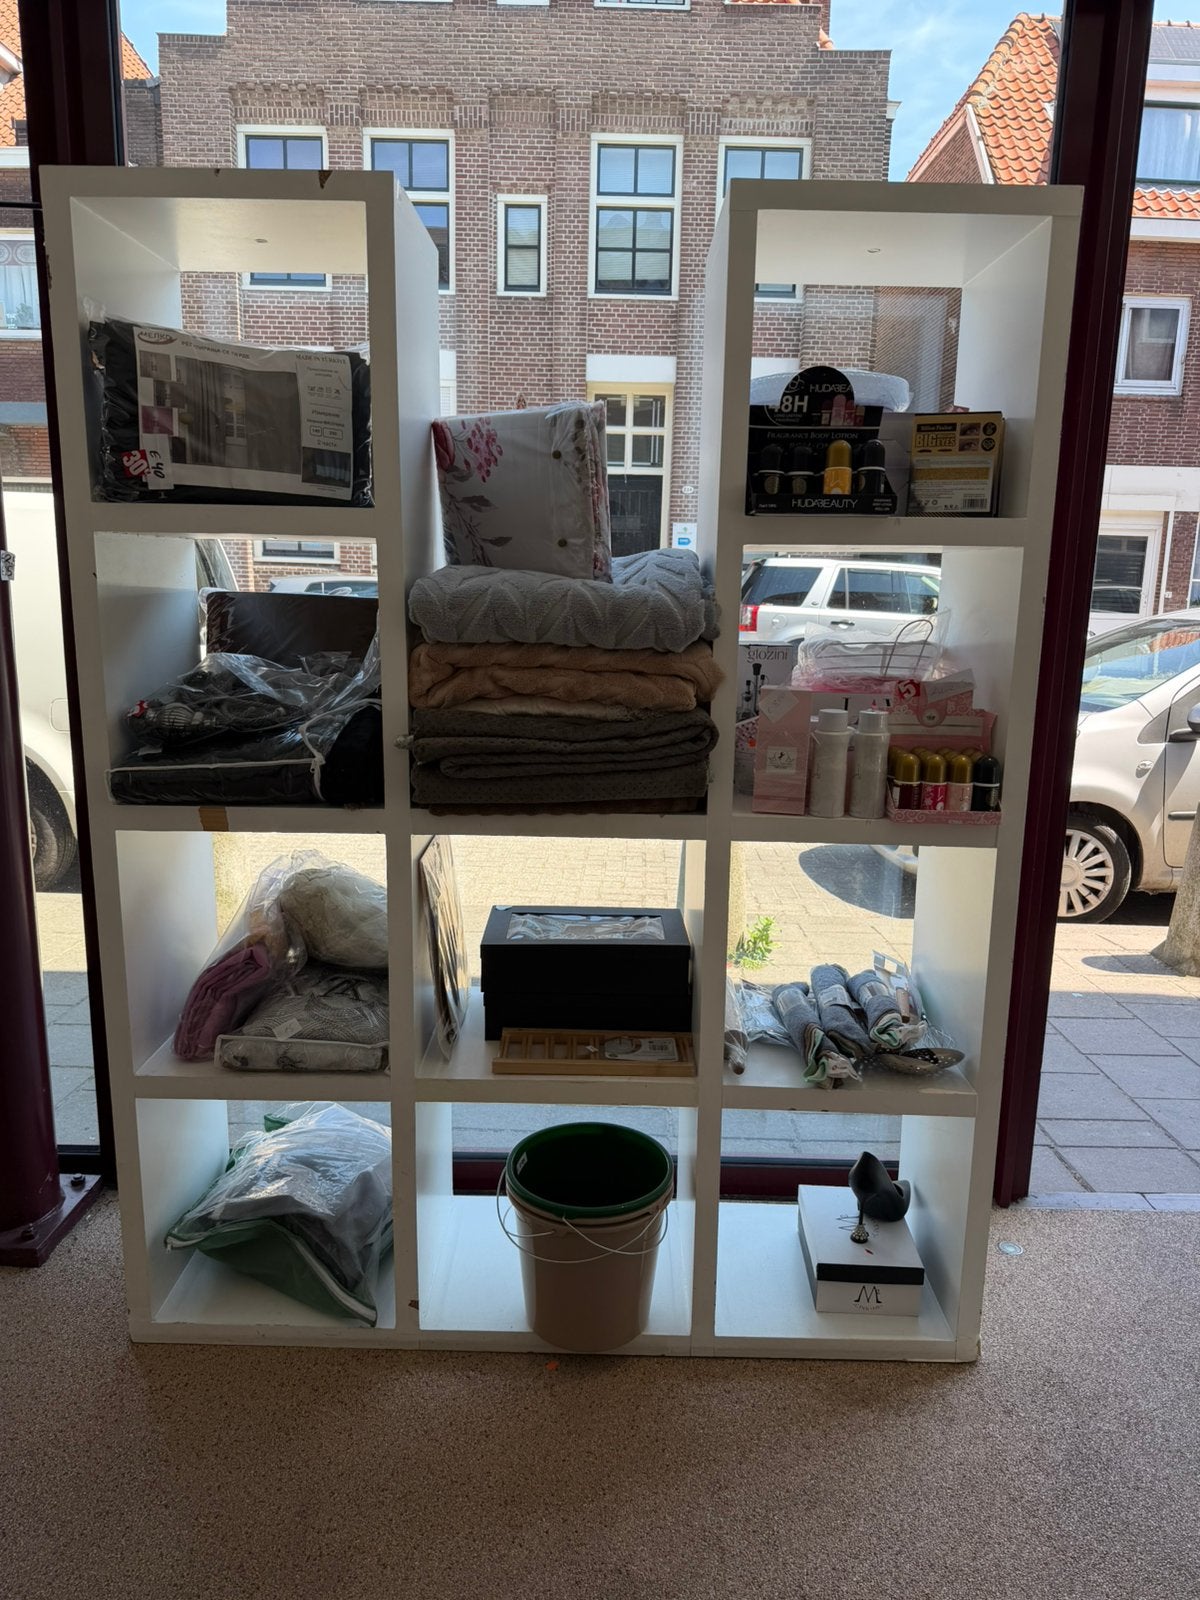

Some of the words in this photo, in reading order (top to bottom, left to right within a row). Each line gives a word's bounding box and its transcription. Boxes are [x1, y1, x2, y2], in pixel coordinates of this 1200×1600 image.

[915, 433, 937, 449] BIG
[791, 498, 859, 509] HUDABEAUTY
[747, 647, 788, 664] glozini
